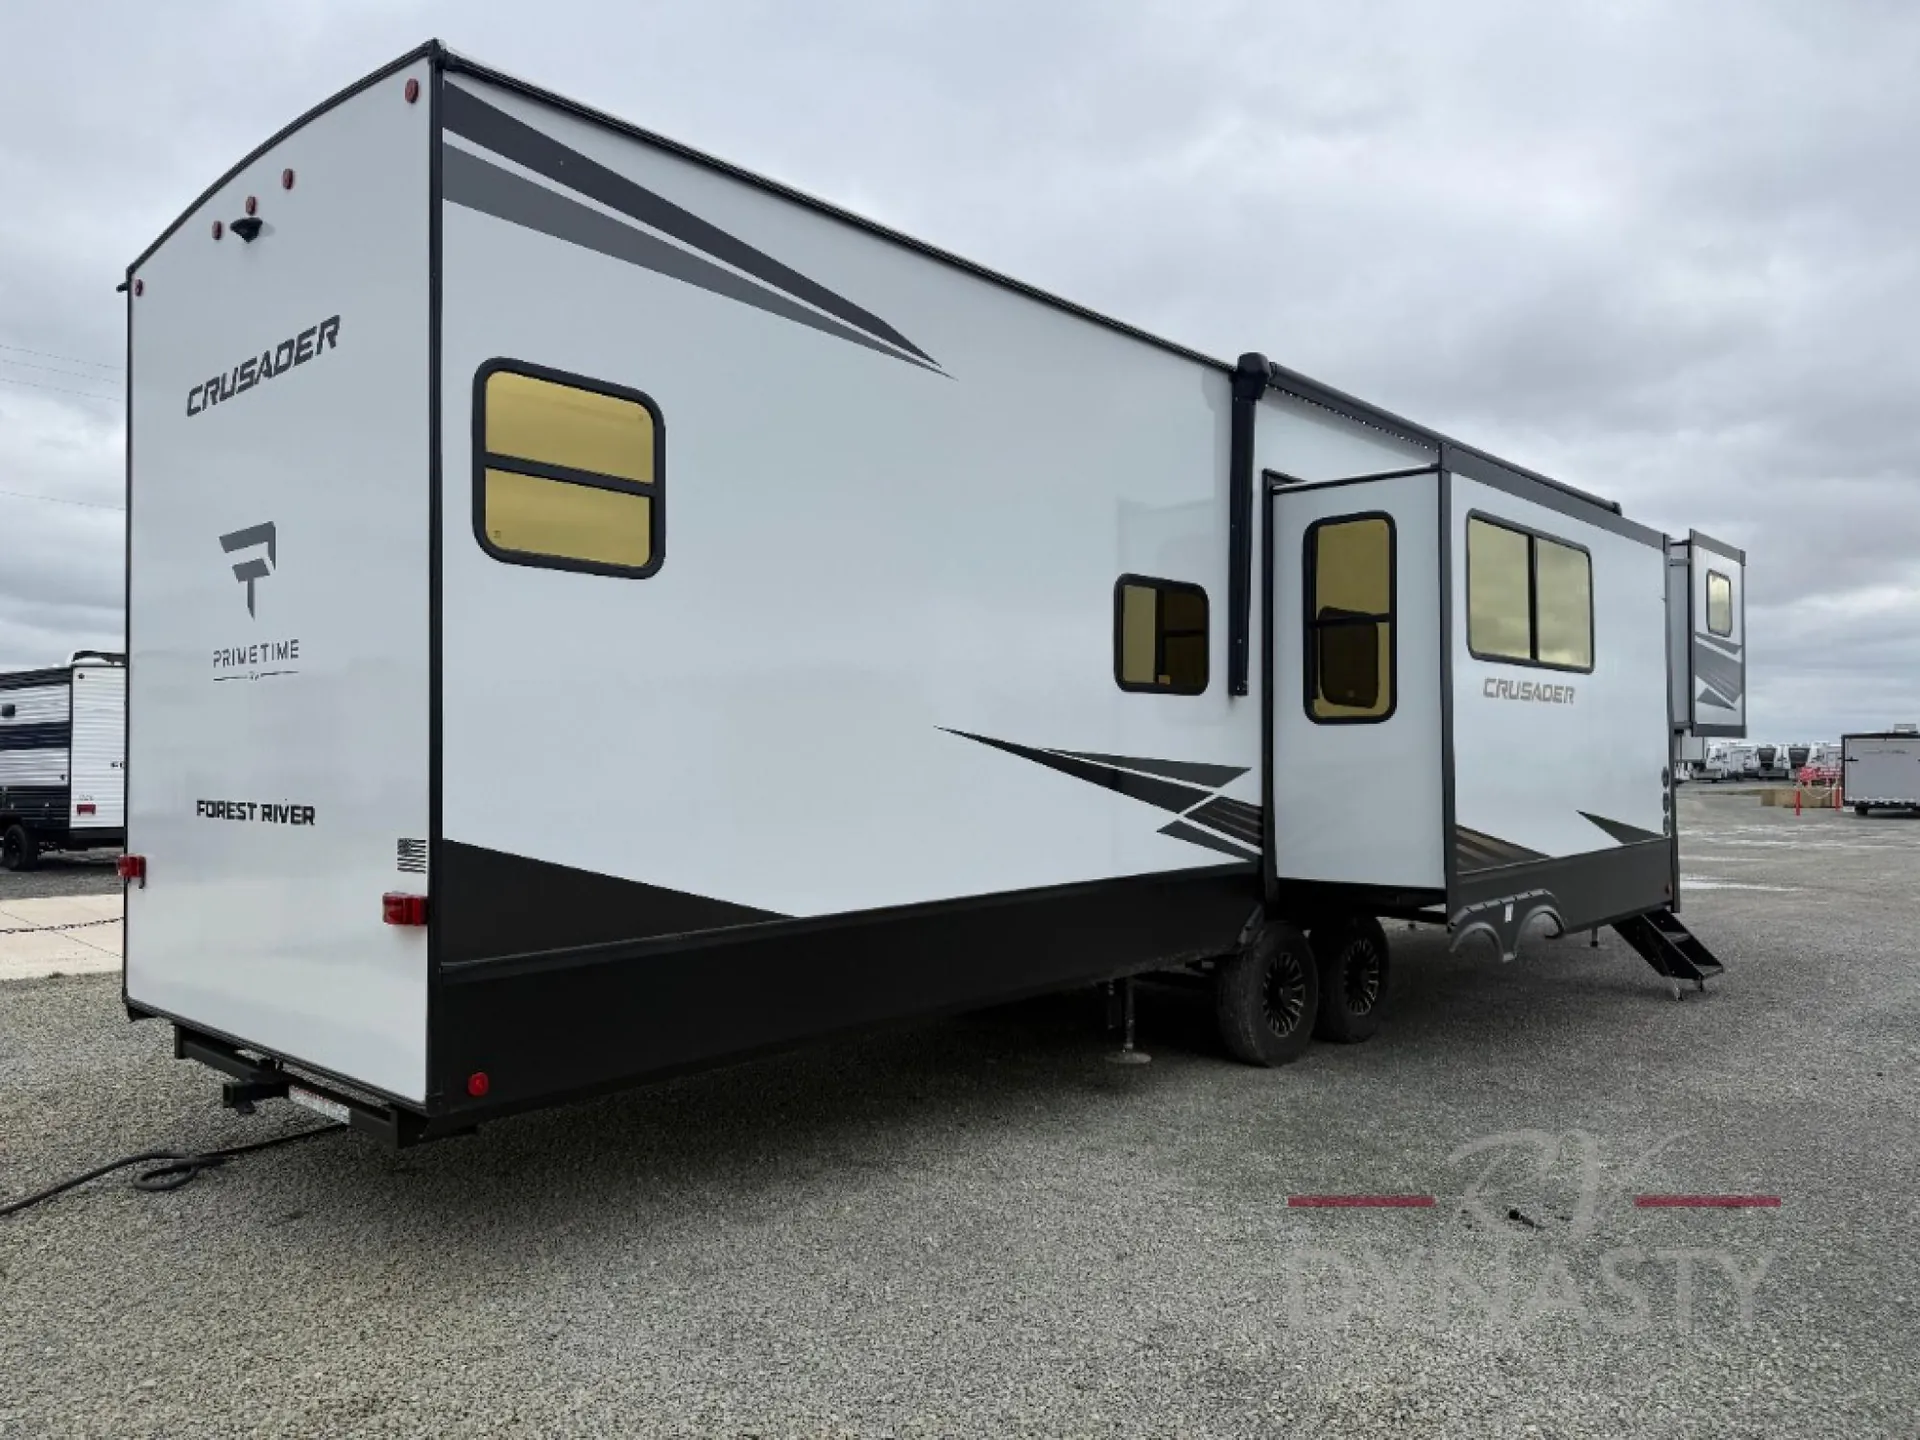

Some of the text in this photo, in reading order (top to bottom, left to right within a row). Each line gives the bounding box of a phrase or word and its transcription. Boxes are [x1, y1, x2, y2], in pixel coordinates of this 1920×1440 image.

[186, 314, 341, 417] CRUSADER
[1483, 677, 1576, 705] CRUSADER
[196, 800, 315, 826] FOREST RIVER
